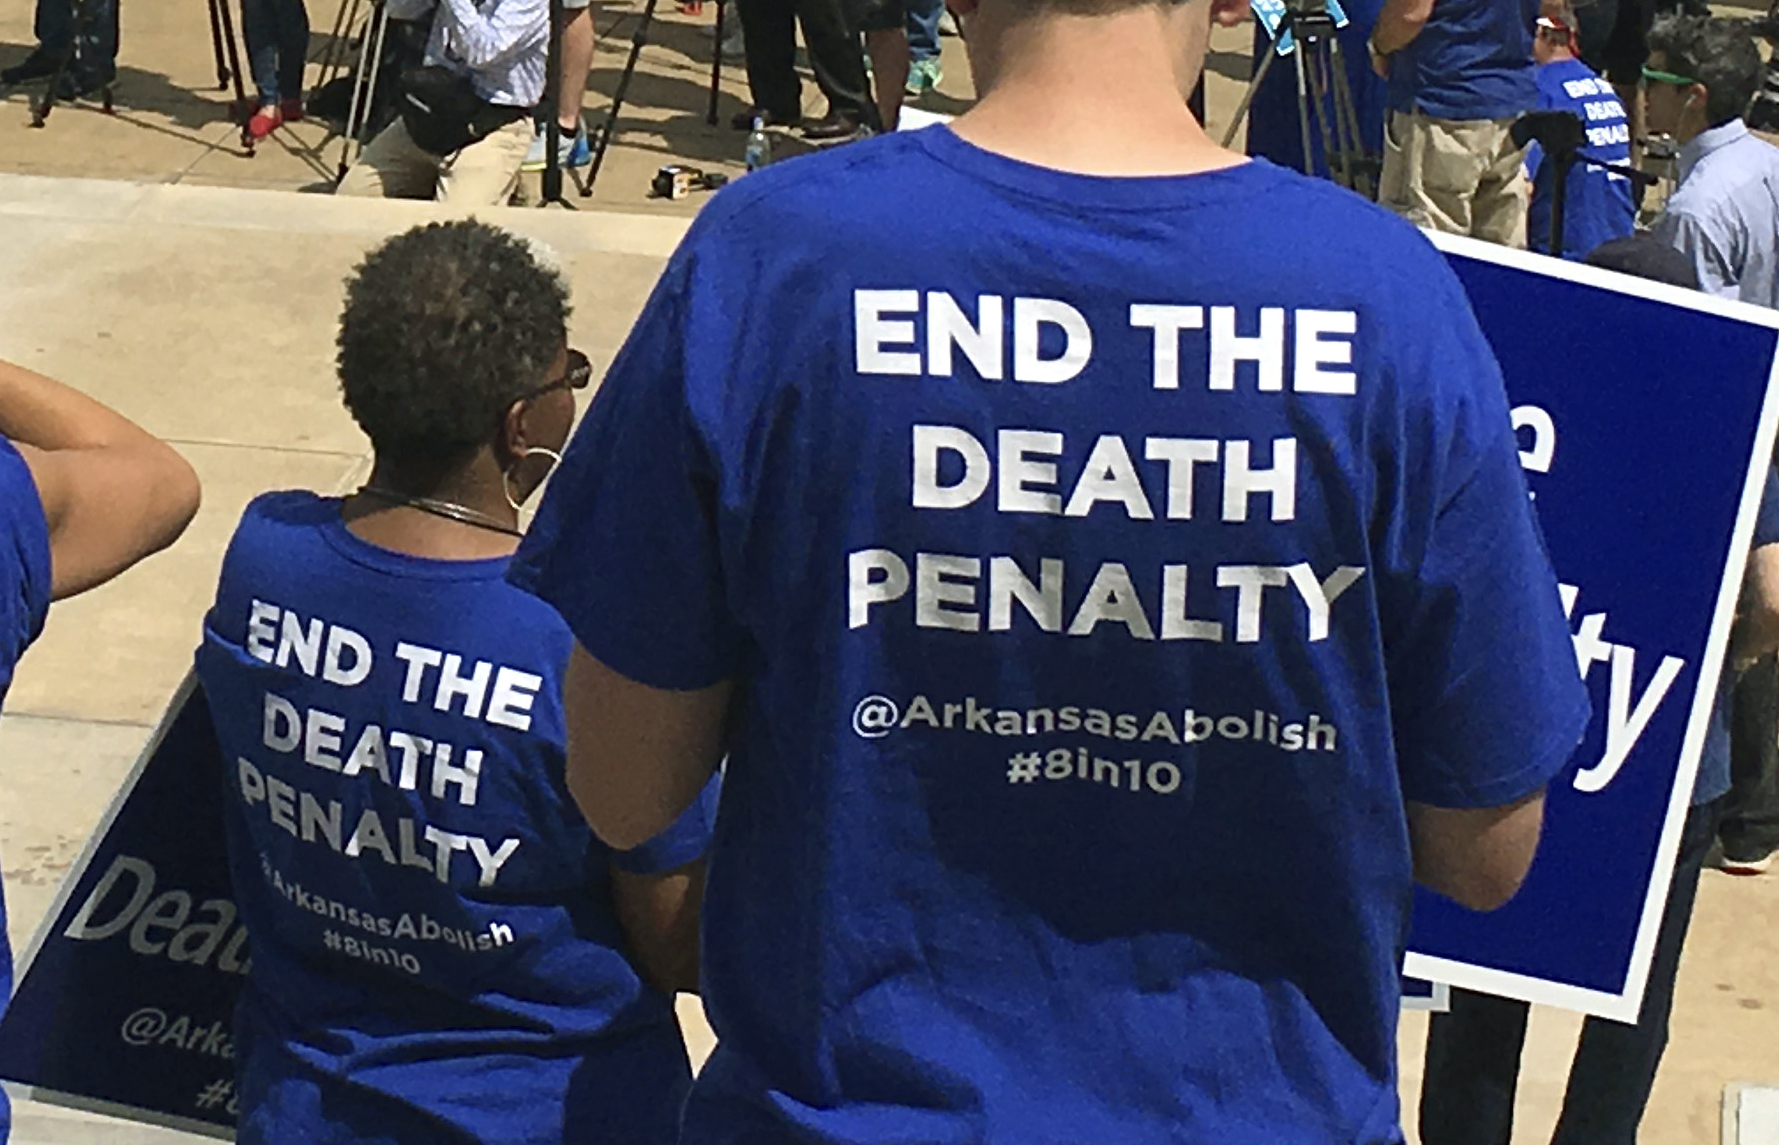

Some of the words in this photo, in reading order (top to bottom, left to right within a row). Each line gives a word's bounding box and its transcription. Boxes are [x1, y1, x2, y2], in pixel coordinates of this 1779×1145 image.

[852, 287, 1092, 384] END
[1130, 303, 1358, 395] THE
[910, 424, 1297, 522] DEATH
[847, 547, 1366, 643] PENALTY
[247, 599, 372, 687] END
[395, 641, 542, 731] THE
[263, 698, 483, 805] DEATH
[850, 694, 1338, 752] @ArkansasAbolish
[1005, 748, 1182, 794] #8in10
[236, 757, 521, 888] PENALTY
[323, 928, 421, 976] #8in10
